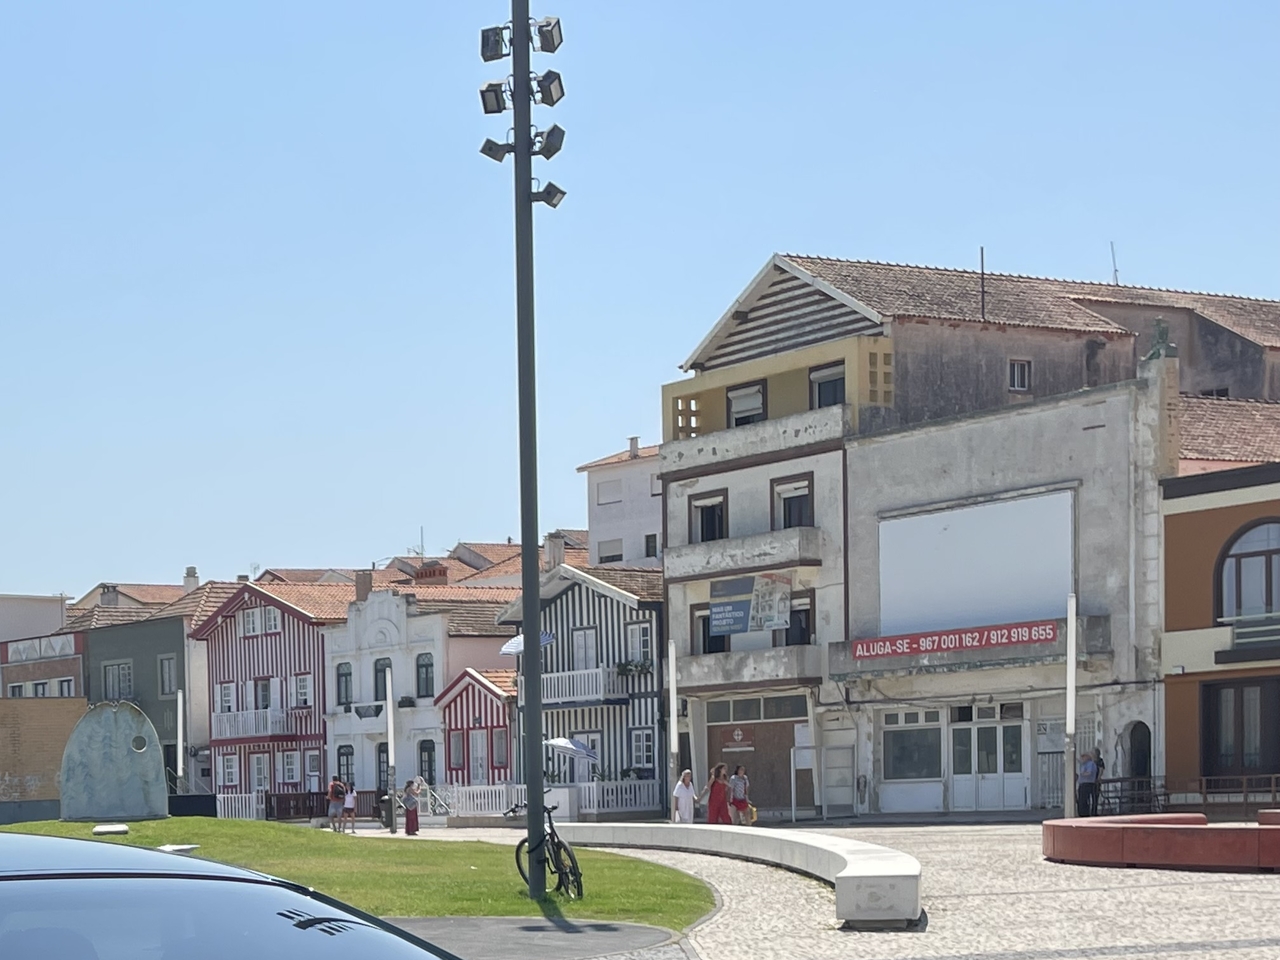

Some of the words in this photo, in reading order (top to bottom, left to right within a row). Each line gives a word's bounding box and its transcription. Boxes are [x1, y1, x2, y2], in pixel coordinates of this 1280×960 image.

[856, 639, 910, 657] ALUGA-SE
[920, 636, 939, 651] 967
[941, 634, 960, 649] 001
[962, 632, 980, 647] 162
[982, 631, 988, 645] /
[990, 629, 1009, 644] 912
[1010, 627, 1029, 642] 919
[1032, 625, 1054, 640] 655
